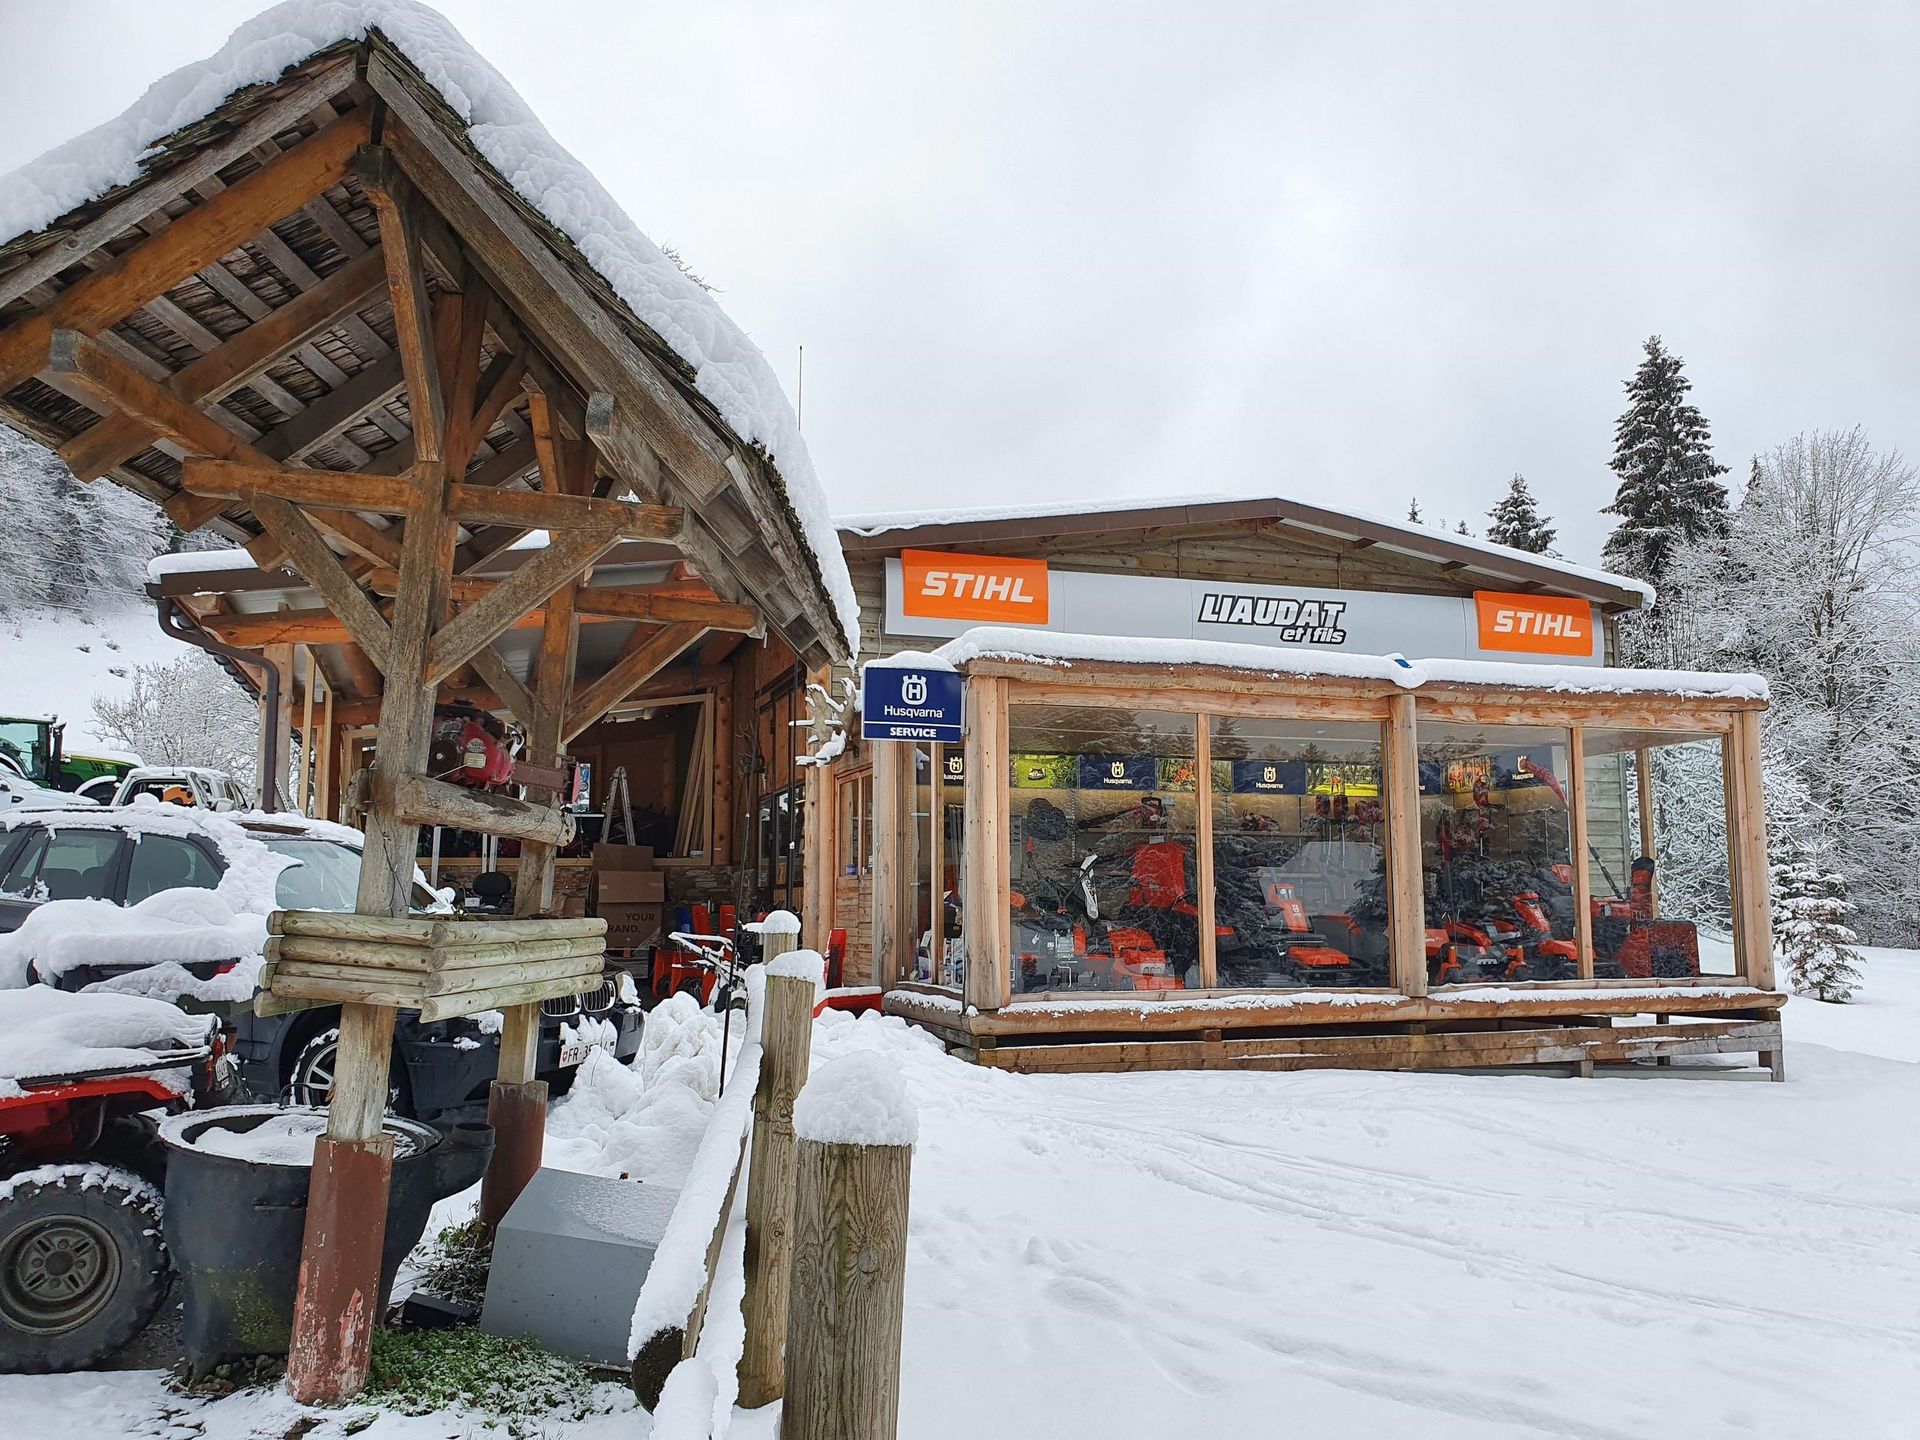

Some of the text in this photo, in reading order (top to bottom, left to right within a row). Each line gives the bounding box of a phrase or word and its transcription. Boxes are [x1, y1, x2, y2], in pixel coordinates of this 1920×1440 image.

[921, 570, 1034, 604] STIHL
[1197, 593, 1347, 628] LIAUDAT
[1493, 609, 1582, 638] STIHL
[1281, 627, 1347, 645] et fils
[884, 704, 944, 719] Husqvarna
[890, 727, 937, 738] SERVICE
[1103, 777, 1133, 785] Husqvarna
[1255, 782, 1284, 790] Husqvarna
[625, 912, 655, 921] YOUR
[608, 924, 641, 933] RAND.
